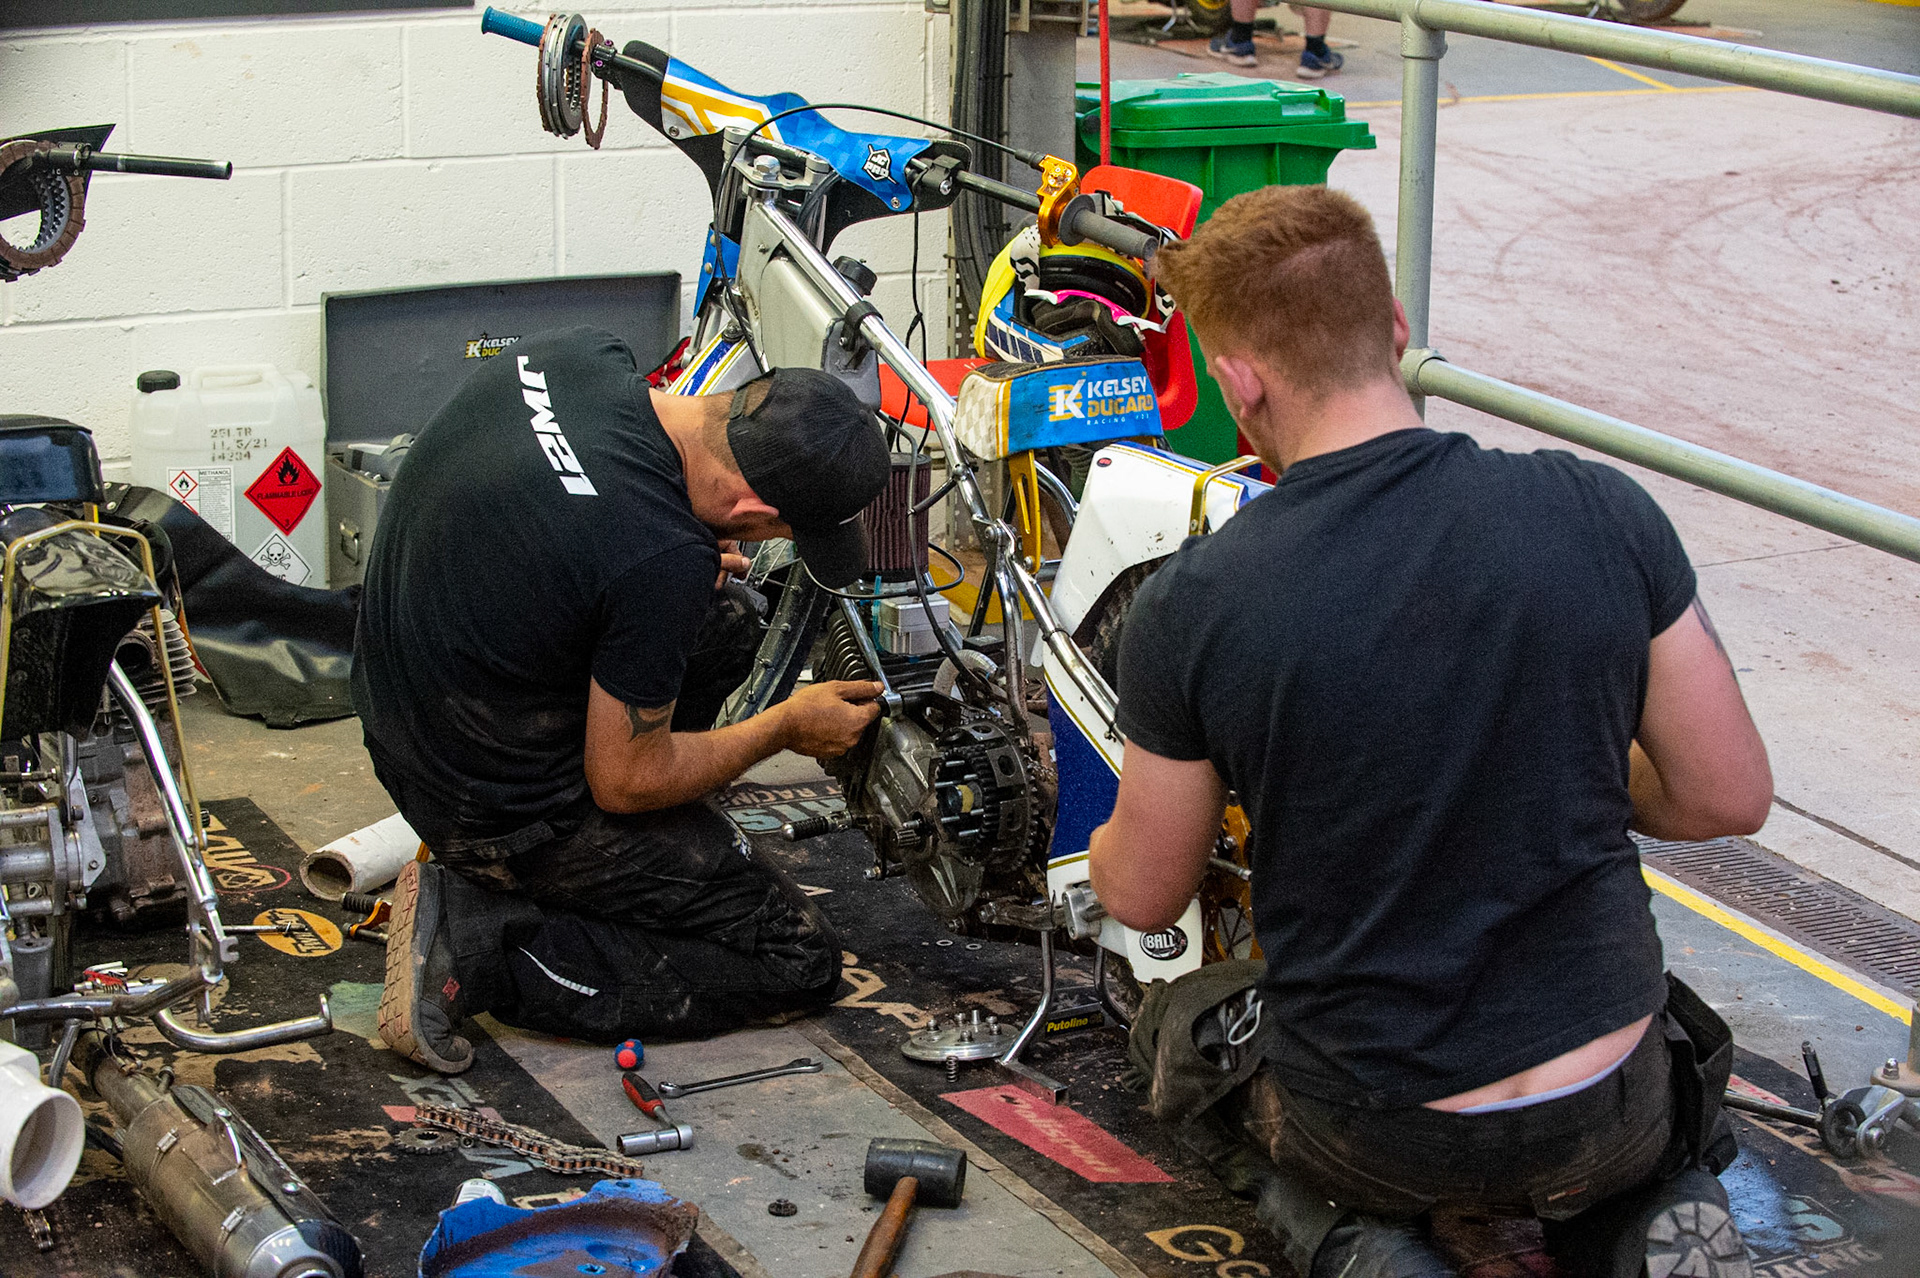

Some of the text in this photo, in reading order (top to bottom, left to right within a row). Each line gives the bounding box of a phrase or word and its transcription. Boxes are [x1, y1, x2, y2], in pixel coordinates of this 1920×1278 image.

[863, 160, 889, 178] PRO
[482, 347, 502, 357] DUG
[1087, 376, 1147, 399] KELSEY
[1087, 394, 1154, 418] DUGARD
[516, 355, 599, 496] JW21
[1086, 416, 1126, 426] RACING
[256, 490, 296, 500] FLAMMABLE
[284, 518, 291, 527] 3
[1146, 932, 1177, 949] BALL
[1046, 1017, 1089, 1033] Putoline
